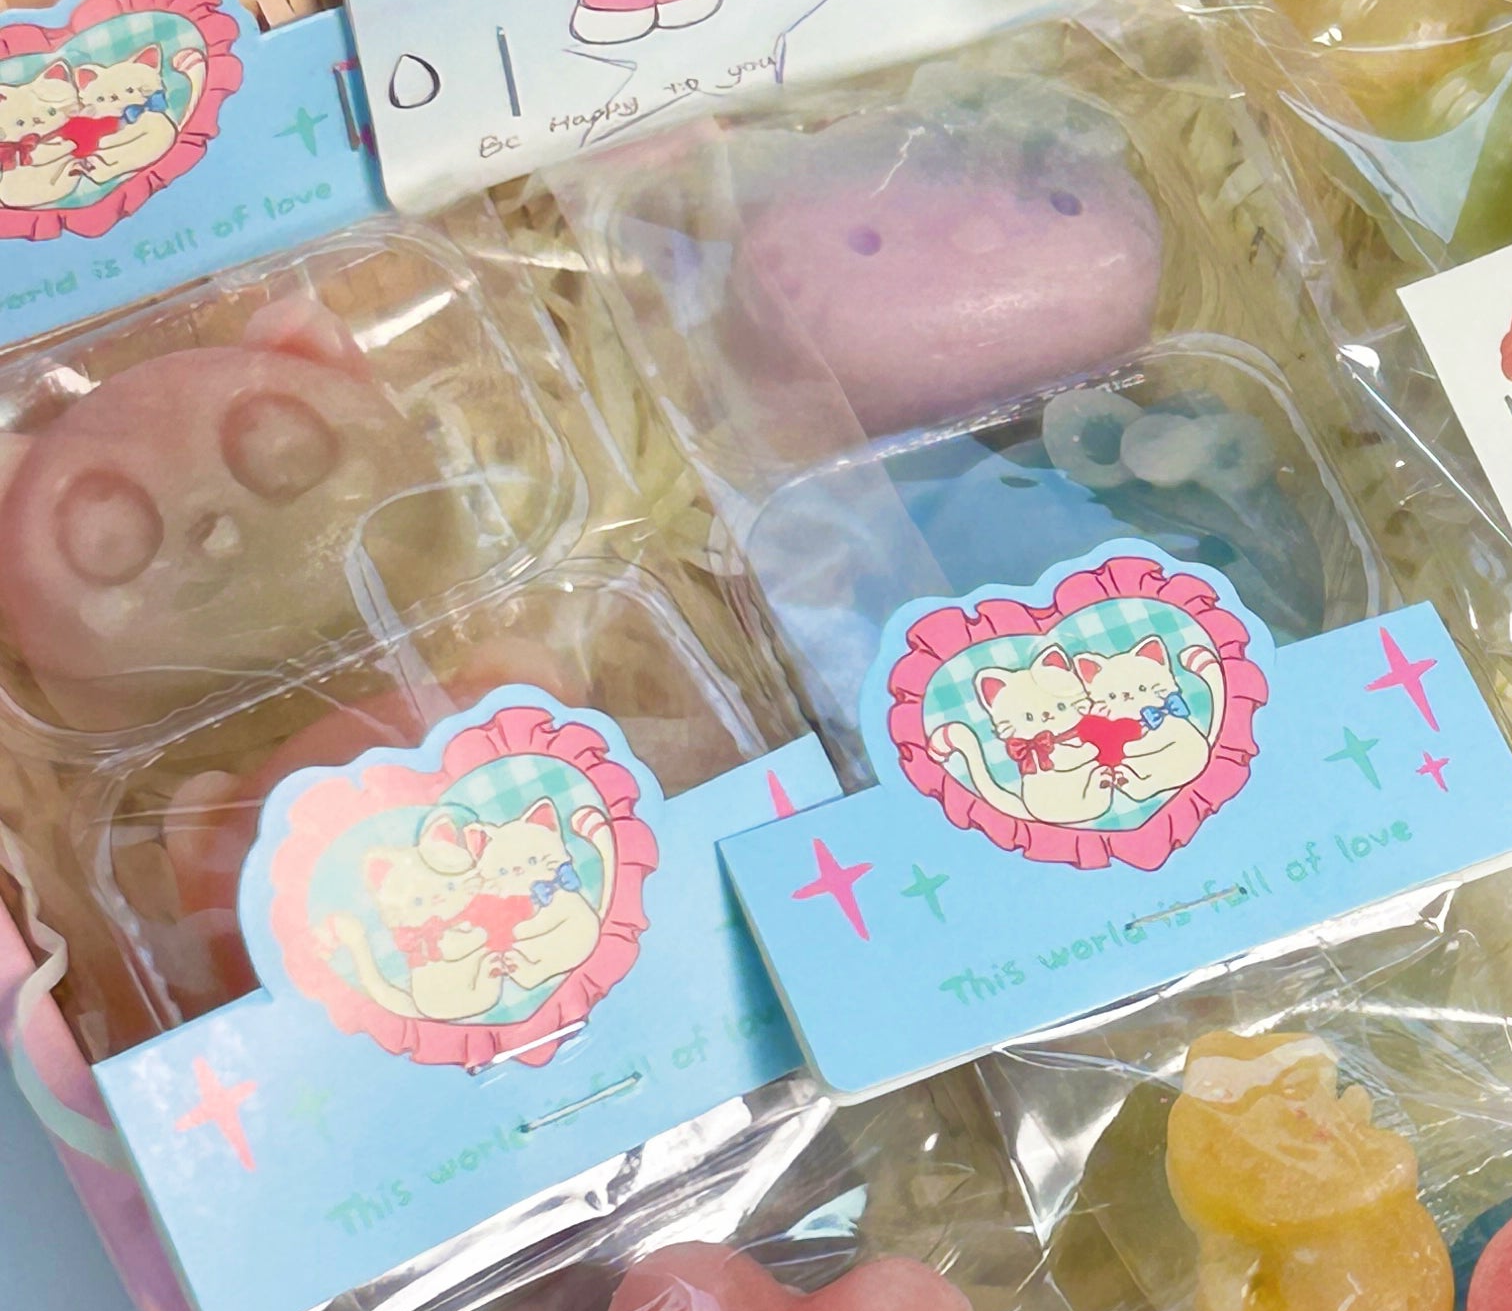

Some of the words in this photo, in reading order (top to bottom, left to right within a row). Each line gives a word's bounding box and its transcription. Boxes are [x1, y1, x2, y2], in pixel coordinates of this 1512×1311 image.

[714, 56, 776, 89] you
[91, 258, 122, 280] is
[133, 227, 197, 266] full
[212, 205, 250, 238] of
[264, 181, 332, 219] love
[939, 958, 1027, 1007] This
[1037, 912, 1149, 971] world
[1285, 841, 1323, 883] of
[1336, 816, 1414, 863] love
[328, 1177, 412, 1235] This
[672, 1027, 709, 1071] of
